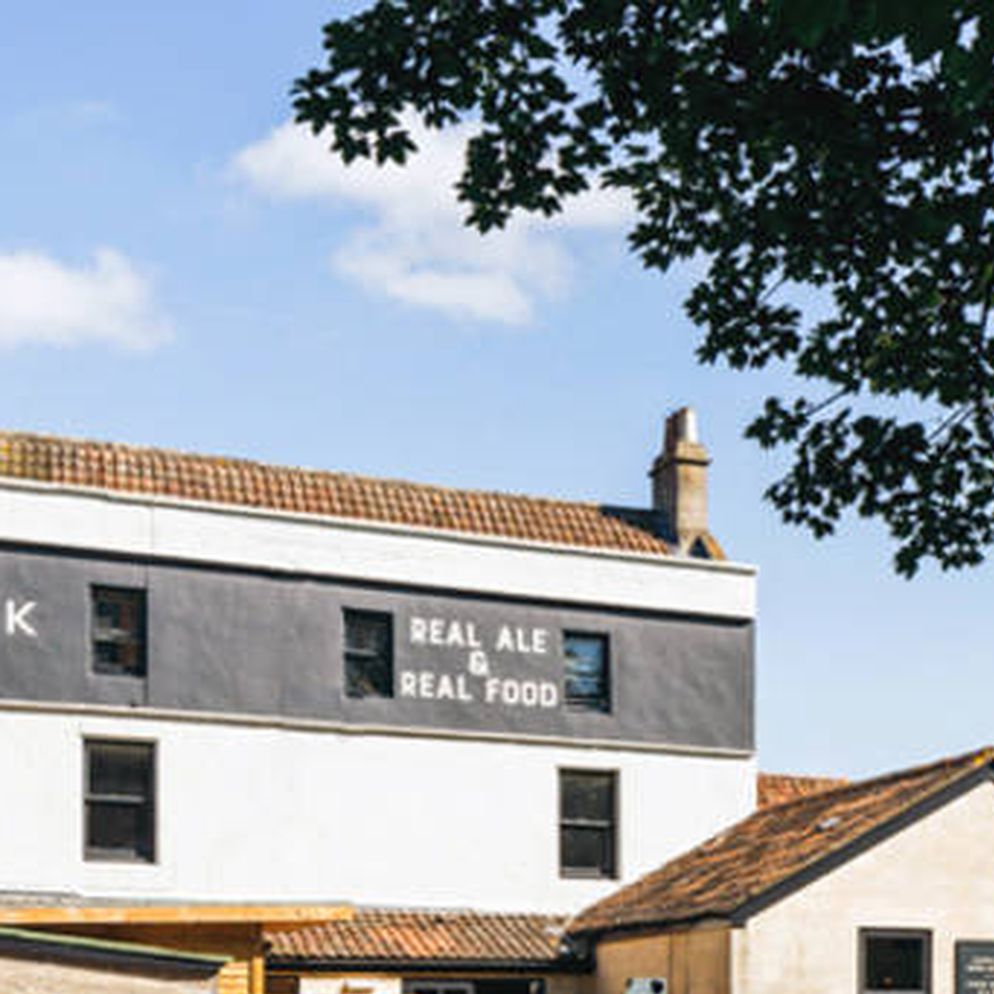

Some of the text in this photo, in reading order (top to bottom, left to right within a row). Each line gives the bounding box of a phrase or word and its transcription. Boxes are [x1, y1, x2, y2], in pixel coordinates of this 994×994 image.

[410, 617, 548, 654] REAL ALE
[468, 650, 490, 676] &
[400, 671, 558, 708] REAL FOOD
